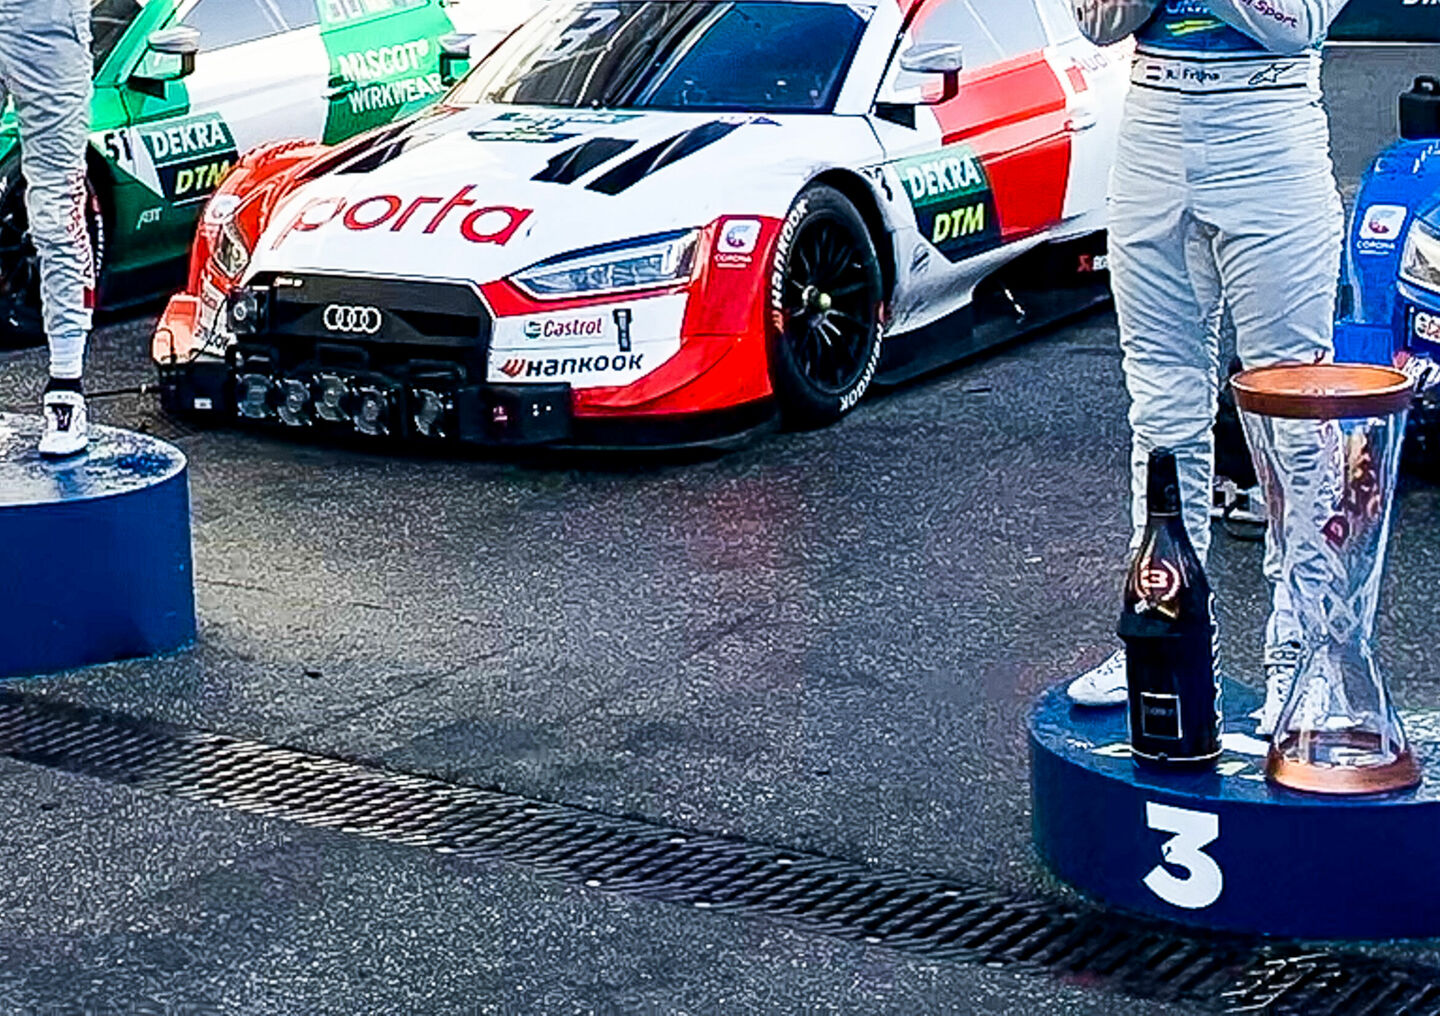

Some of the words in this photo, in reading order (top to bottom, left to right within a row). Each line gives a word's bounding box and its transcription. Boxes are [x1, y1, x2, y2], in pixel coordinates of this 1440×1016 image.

[151, 119, 227, 159] DEKRA
[906, 155, 983, 200] DEKRA
[270, 184, 534, 250] porta
[932, 202, 985, 244] DTM
[543, 317, 602, 339] Castrol
[1142, 801, 1224, 910] 3
